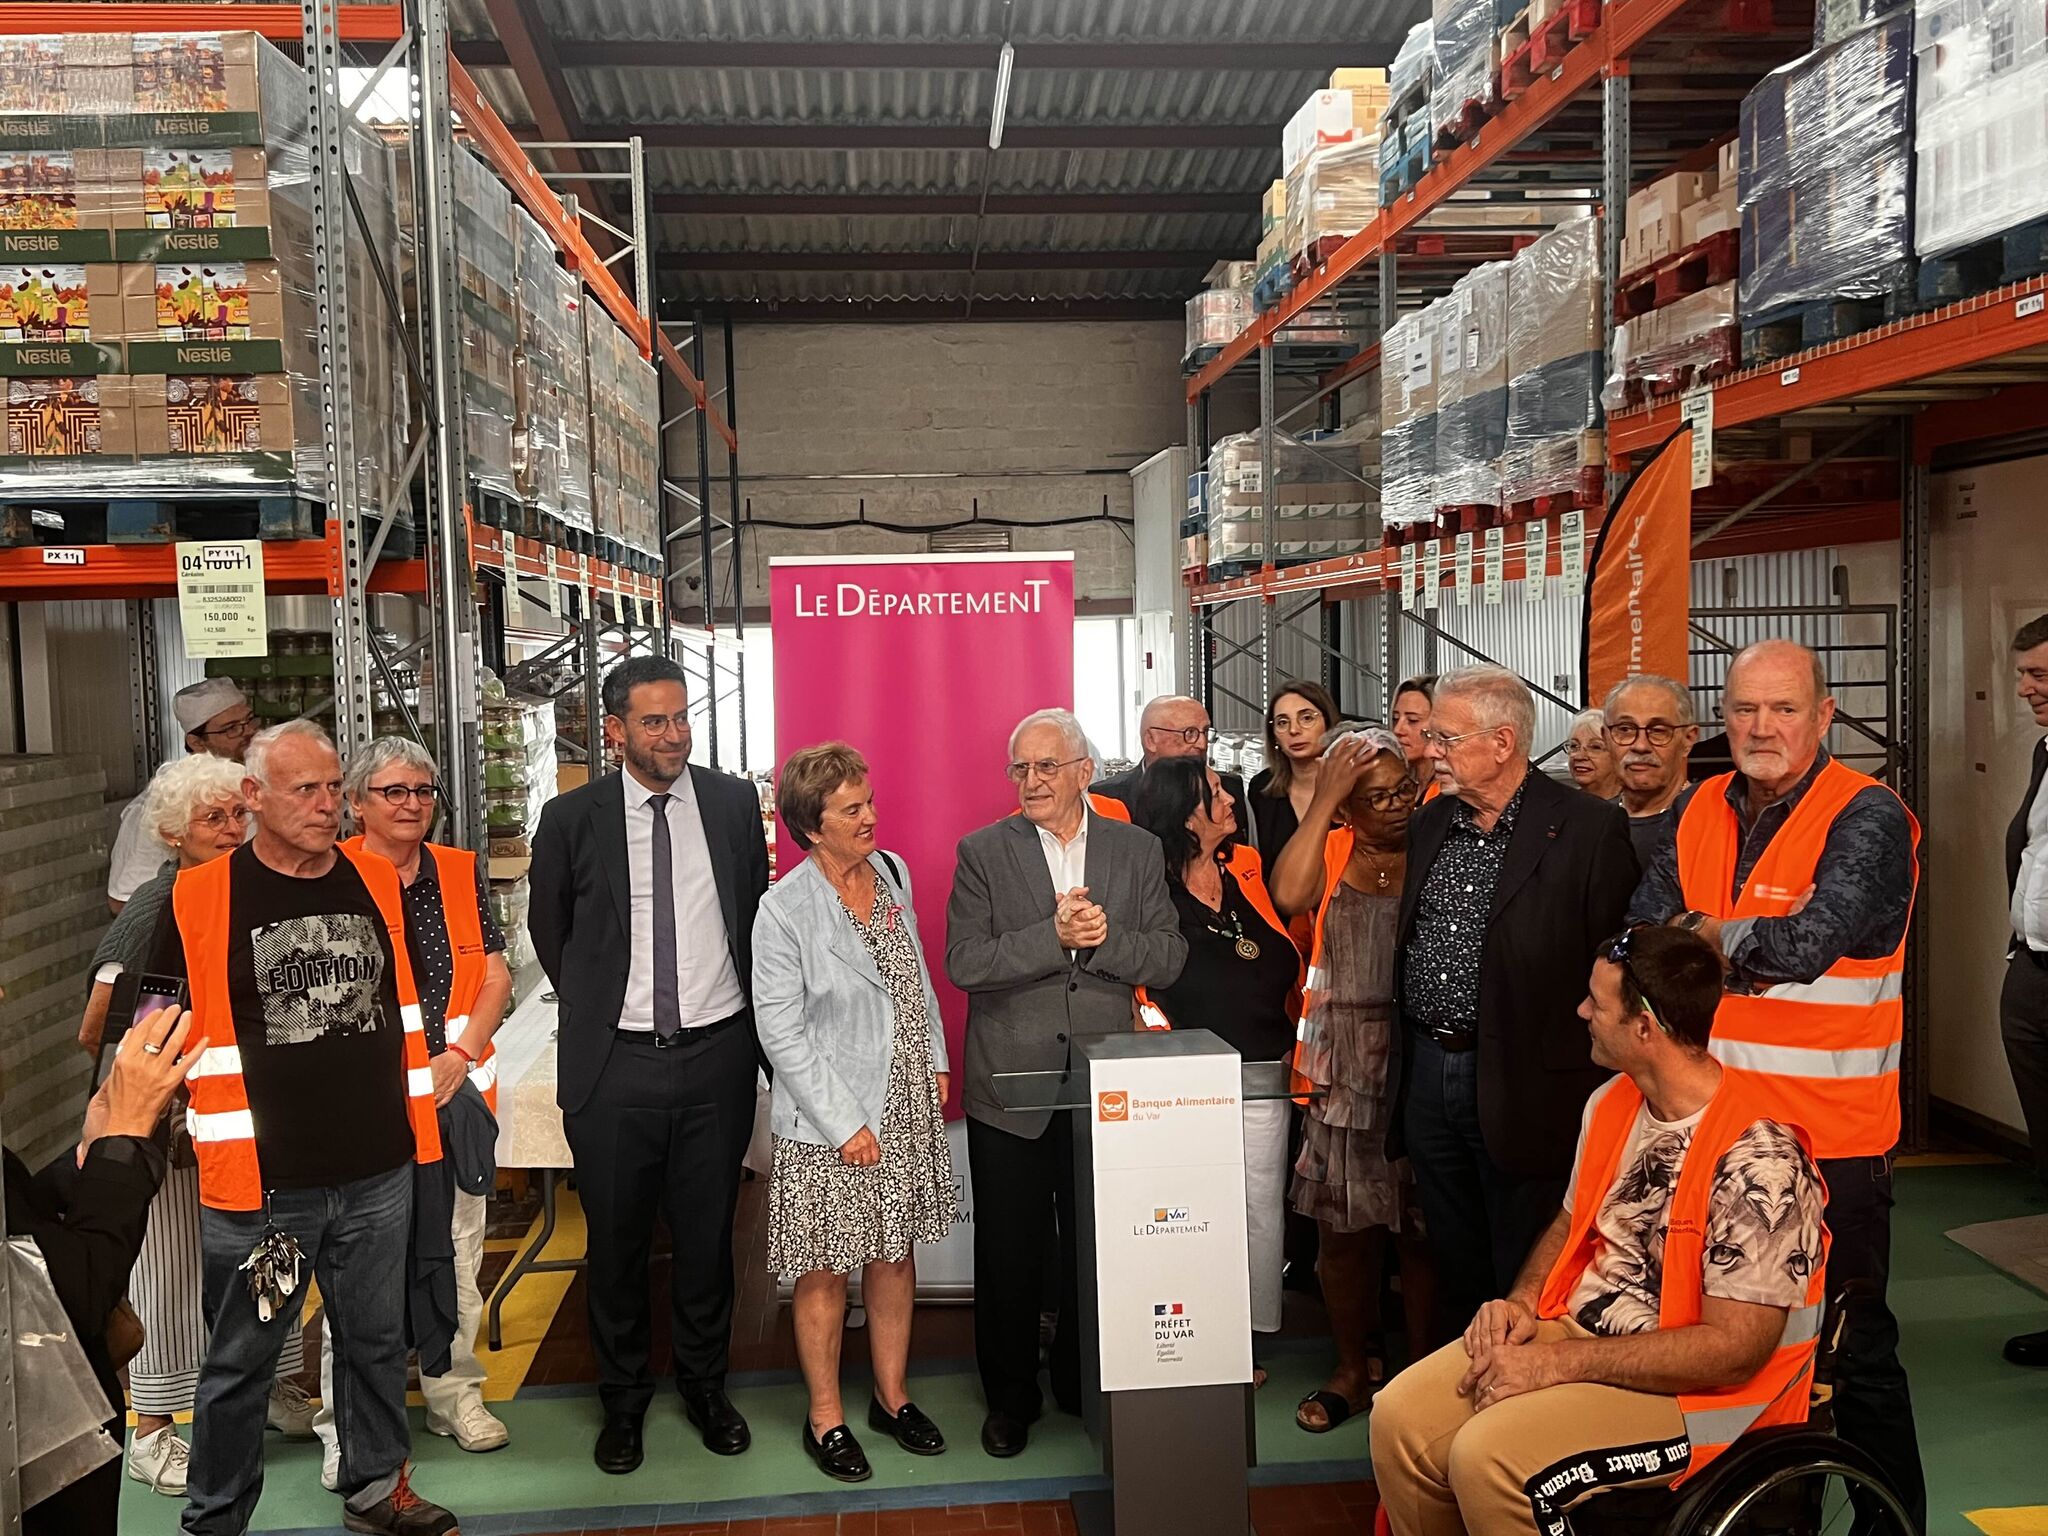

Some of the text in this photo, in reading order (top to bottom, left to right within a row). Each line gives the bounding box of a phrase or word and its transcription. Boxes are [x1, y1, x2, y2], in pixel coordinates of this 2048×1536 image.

[155, 118, 210, 135] Nestlé
[5, 235, 60, 251] Nestlé
[165, 233, 220, 250] Nestlé
[16, 348, 72, 365] Nestlé
[177, 347, 232, 363] Nestlé
[836, 579, 1050, 617] DÉPARTEMENT
[1625, 515, 1645, 678] limentaires
[203, 612, 239, 621] 150,000
[267, 955, 377, 994] EDITION
[1132, 1096, 1236, 1110] Banque Alimentaire
[1132, 1112, 1161, 1121] du Var
[1154, 1318, 1192, 1329] PRÉFET
[1155, 1329, 1195, 1340] DU VAR
[1540, 1461, 1598, 1497] Dream
